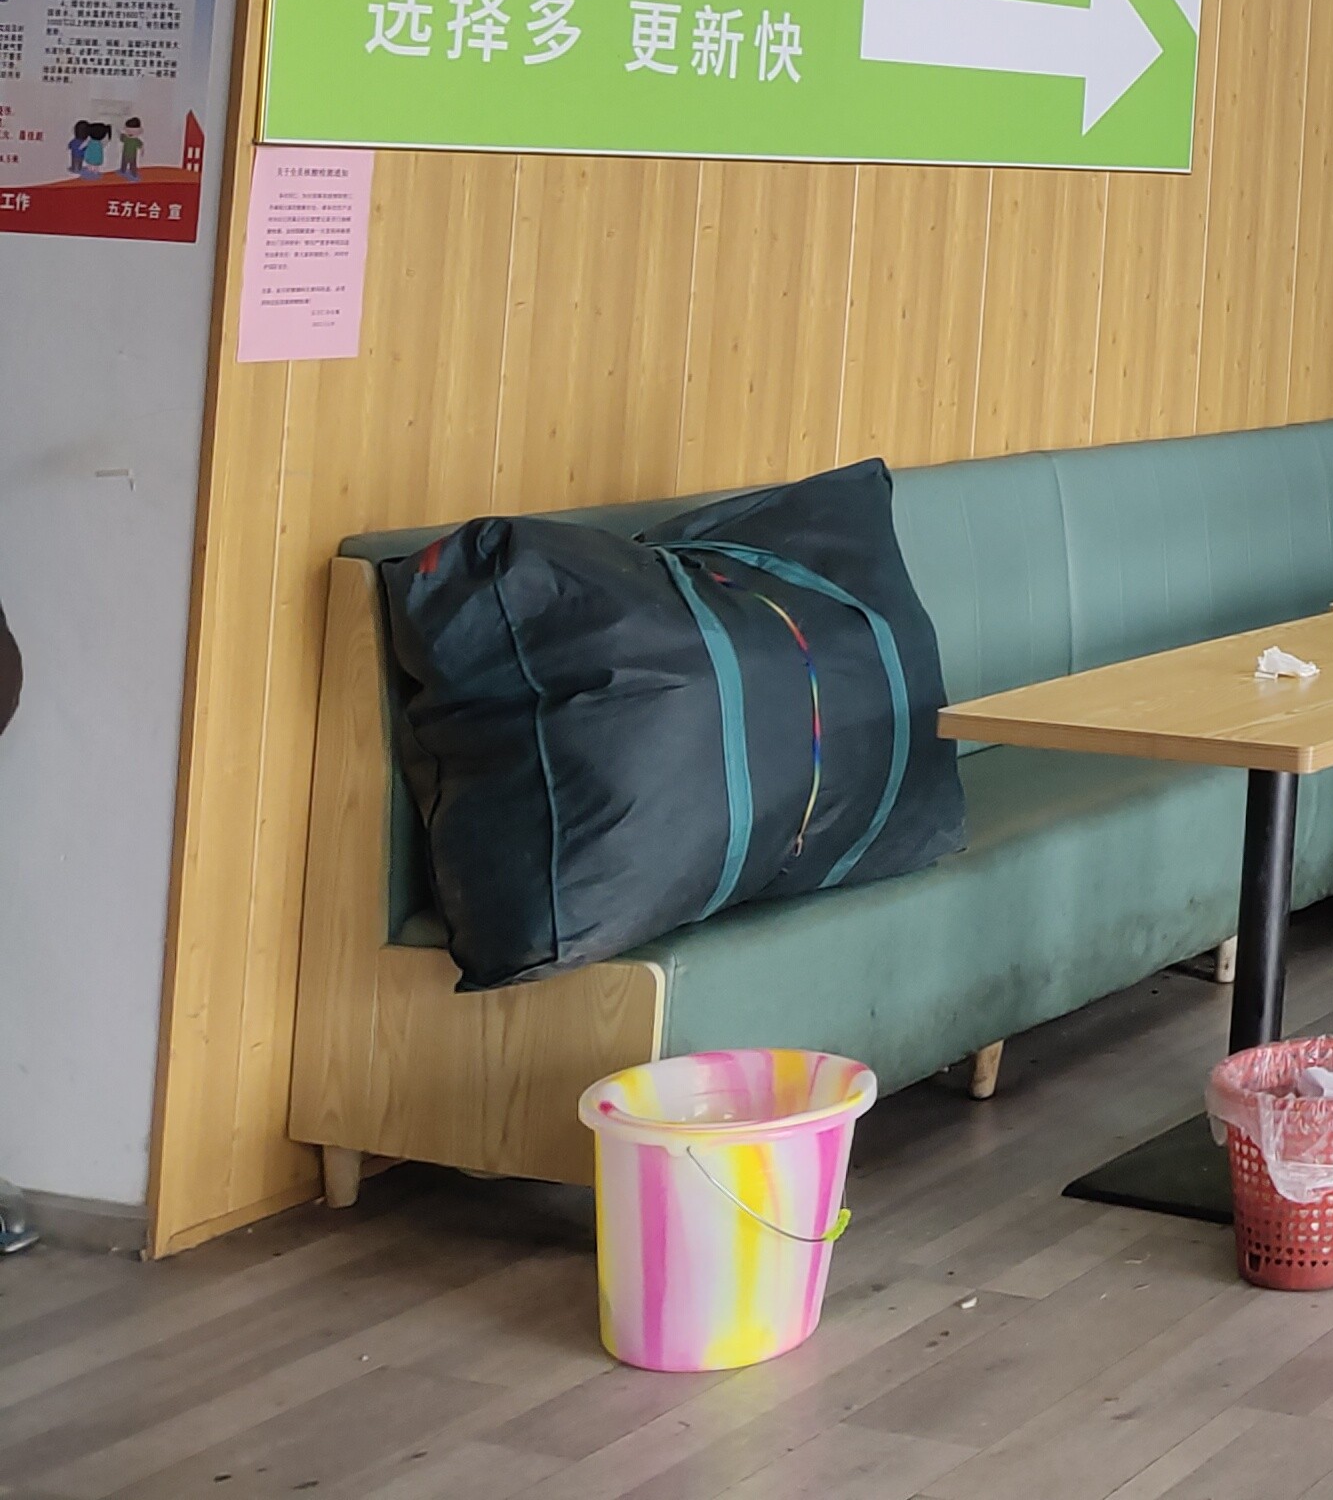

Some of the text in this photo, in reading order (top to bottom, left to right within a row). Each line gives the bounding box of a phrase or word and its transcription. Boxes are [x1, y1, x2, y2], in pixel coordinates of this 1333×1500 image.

[625, 0, 804, 85] 更新快
[106, 200, 182, 220] 五方仁合 宣
